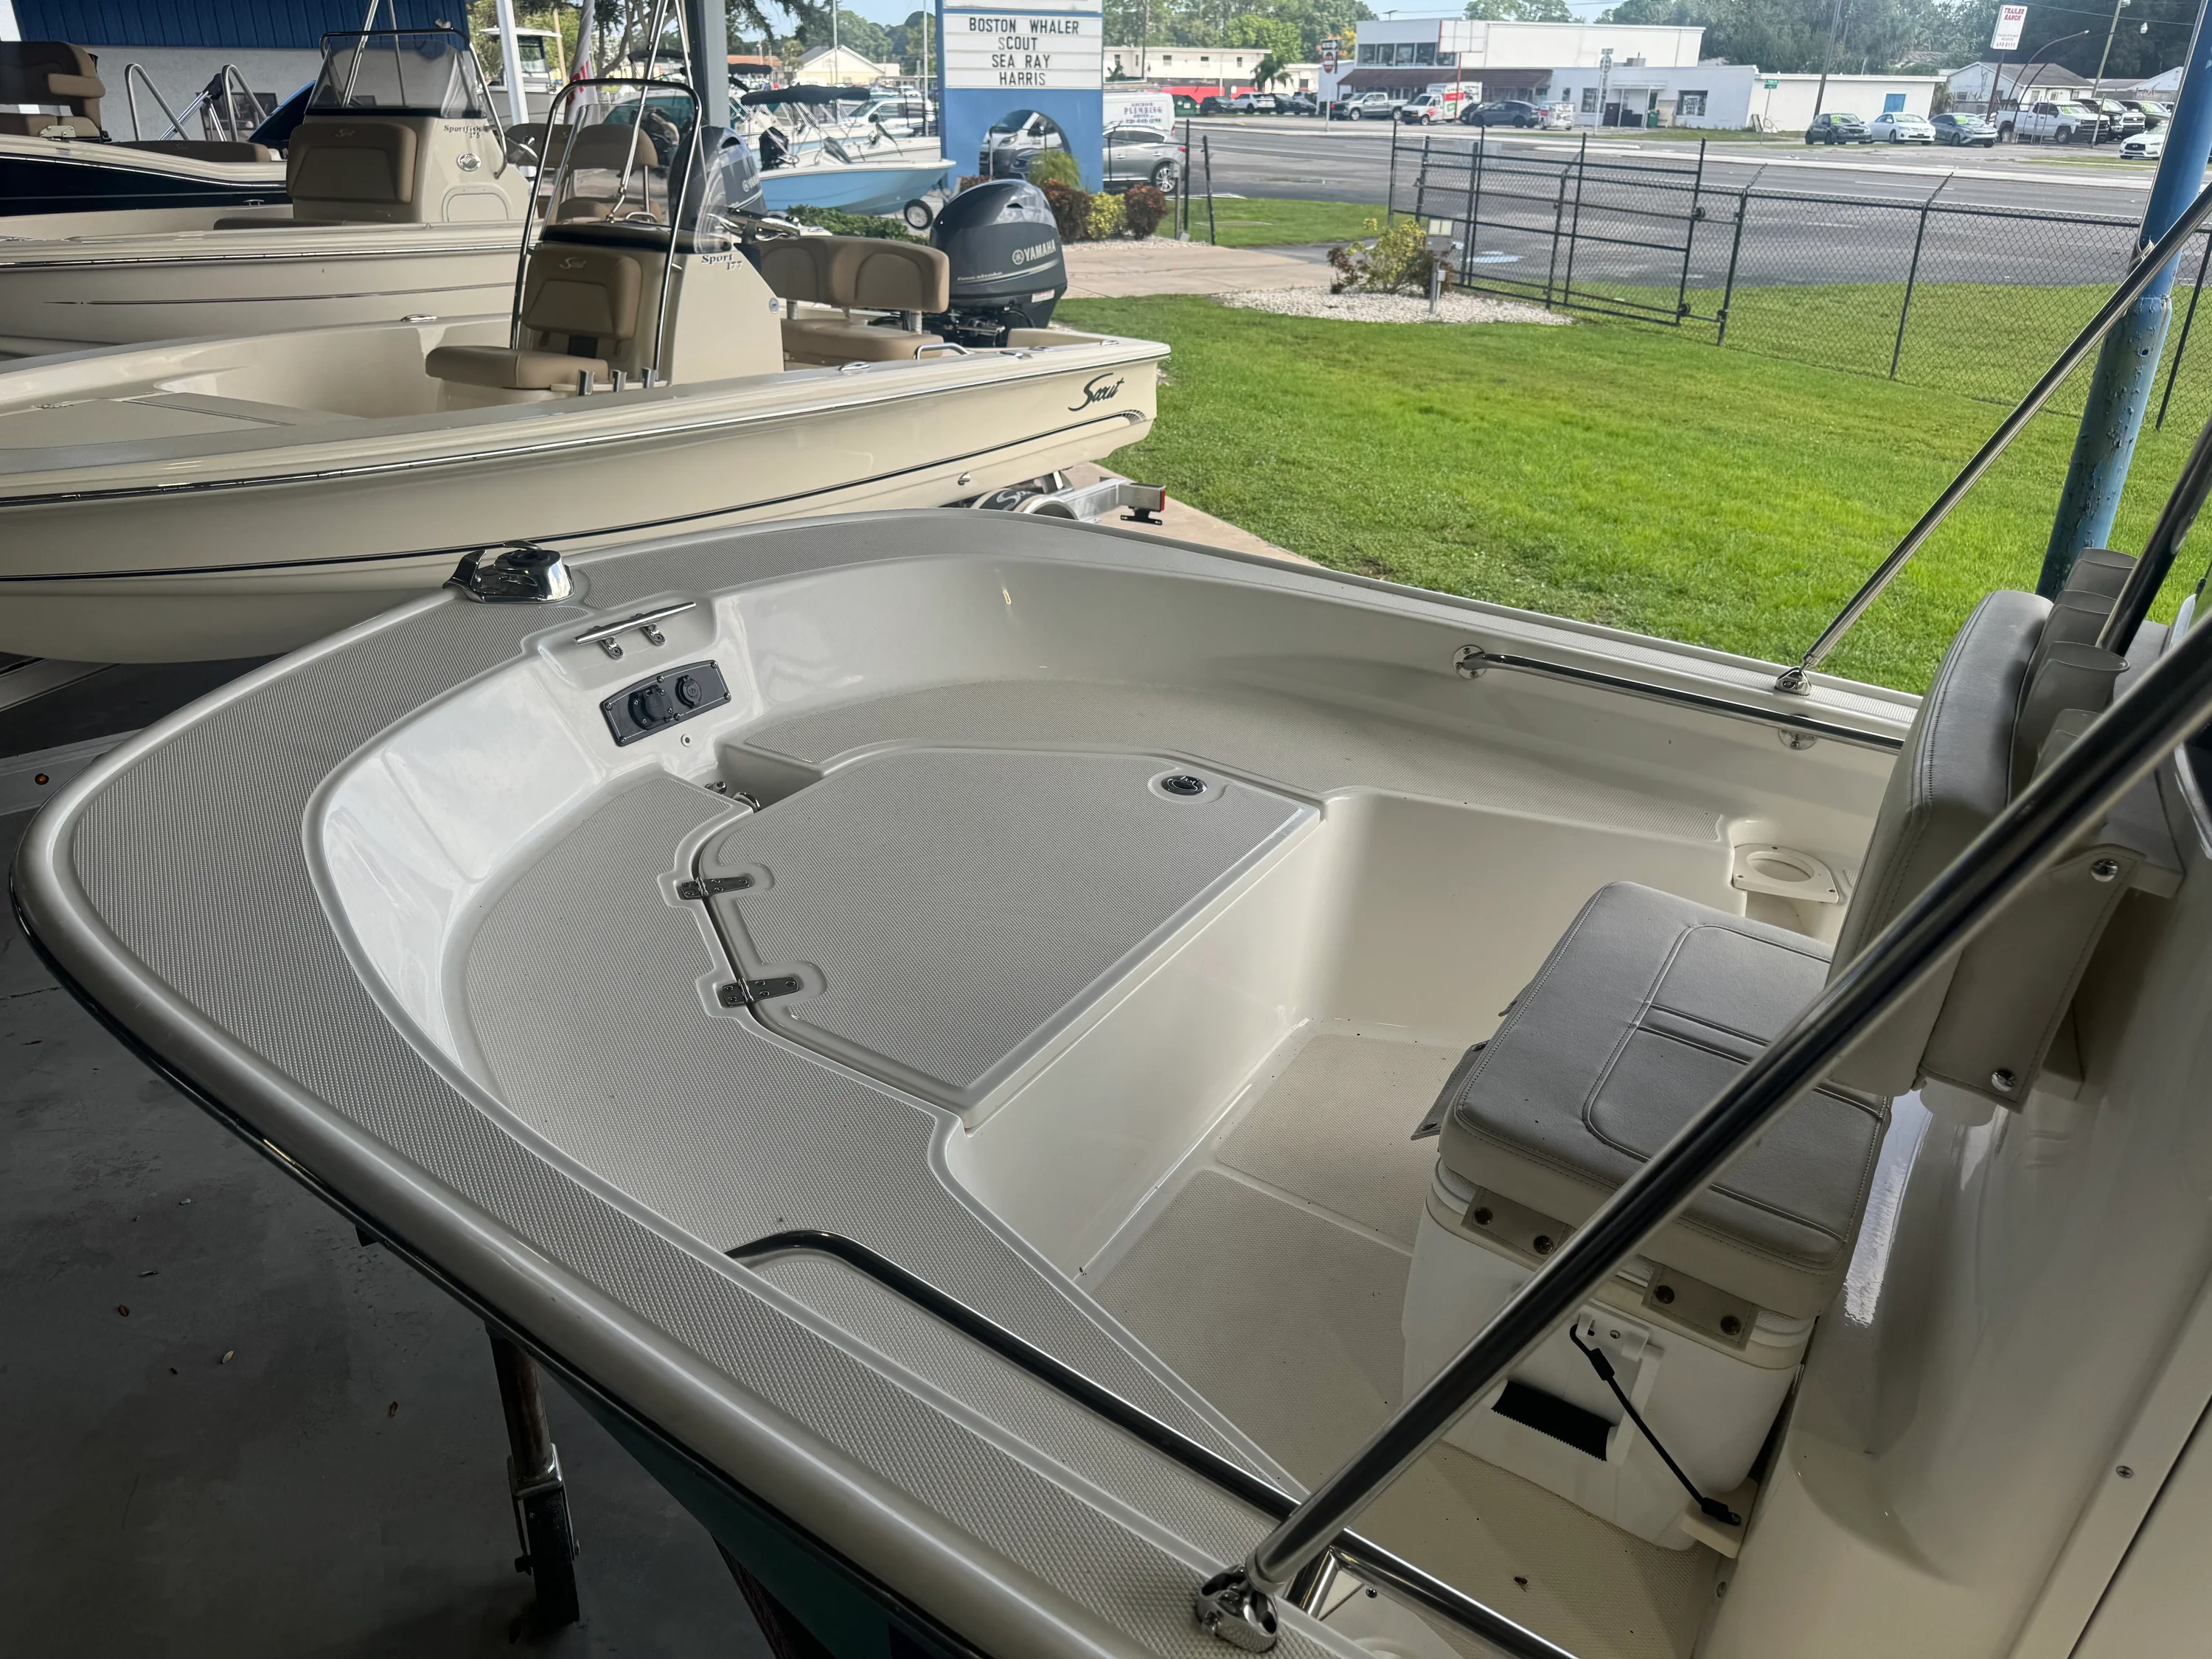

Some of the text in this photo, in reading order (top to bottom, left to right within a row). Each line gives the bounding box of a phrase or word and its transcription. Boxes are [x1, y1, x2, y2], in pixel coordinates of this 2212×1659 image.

[969, 17, 1079, 34] BOSTON WHALER
[998, 36, 1037, 51] SCOUT
[992, 54, 1050, 69] SEA RAY
[999, 72, 1046, 86] HARRIS
[1023, 239, 1057, 262] YAMAHA
[701, 254, 734, 265] Sport
[726, 261, 742, 271] 177
[1068, 372, 1124, 412] Scout
